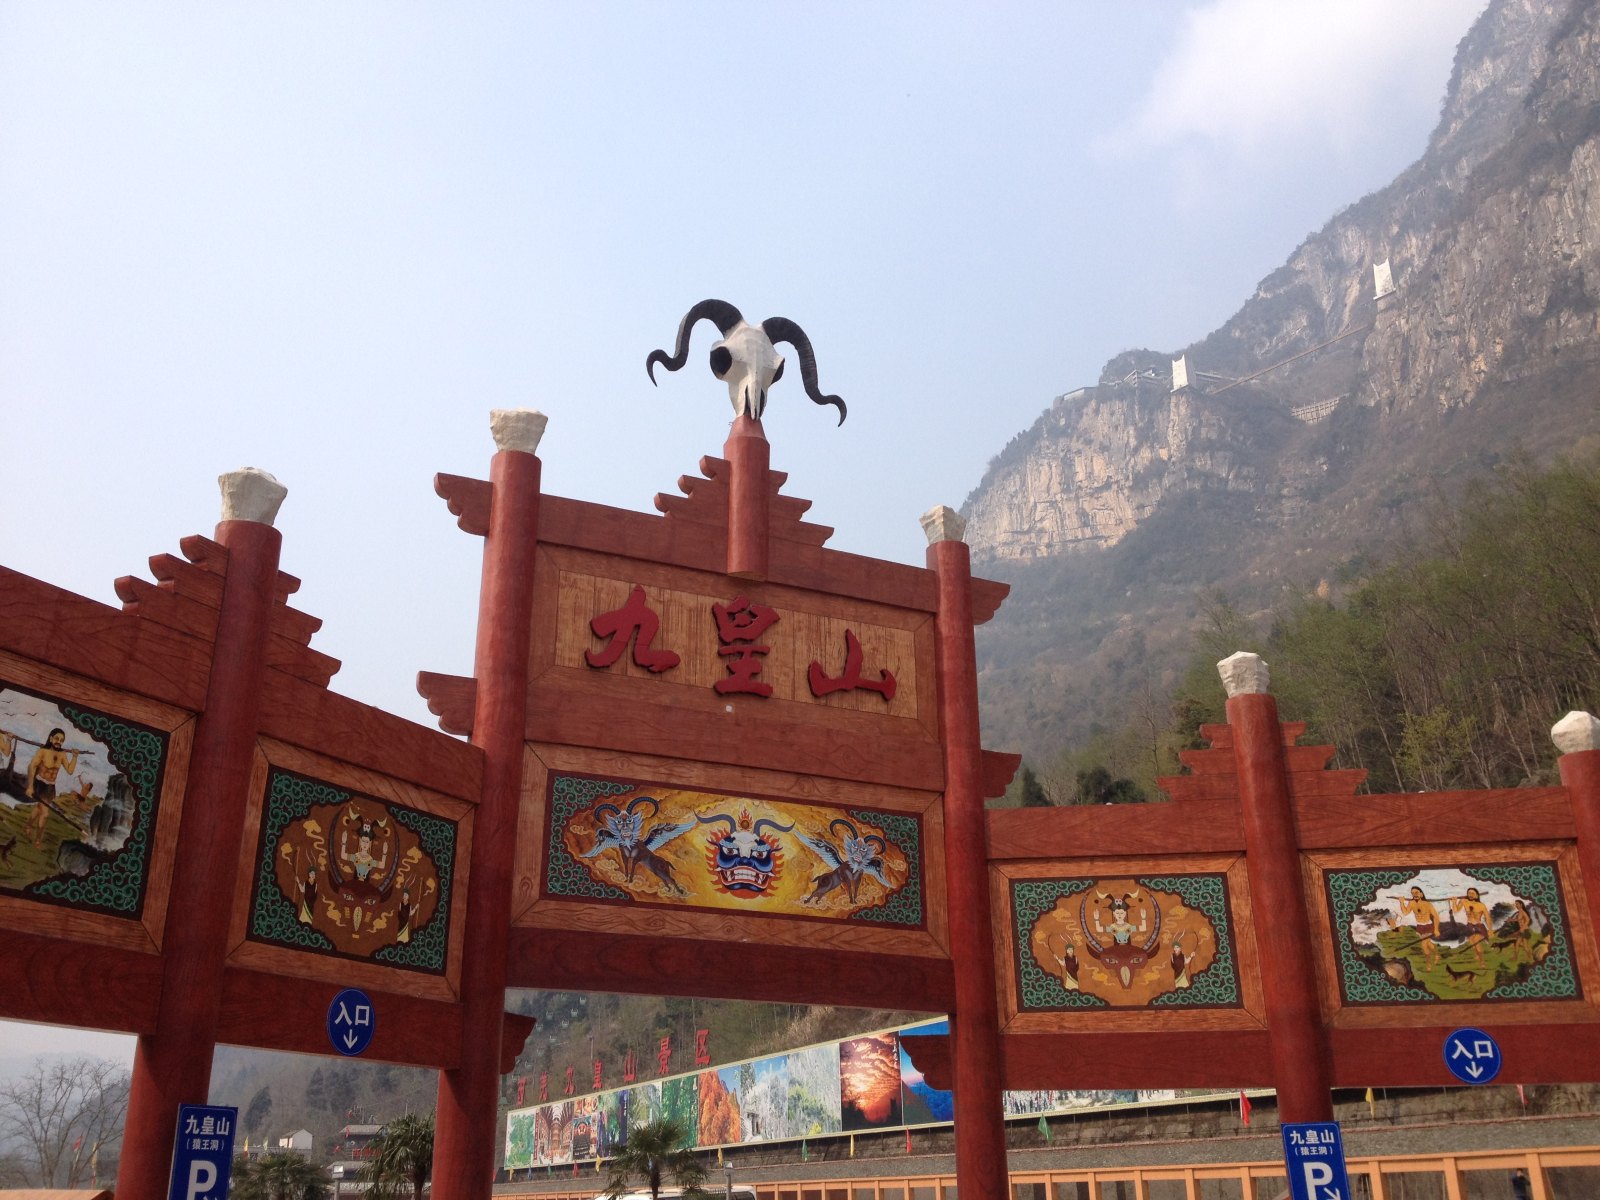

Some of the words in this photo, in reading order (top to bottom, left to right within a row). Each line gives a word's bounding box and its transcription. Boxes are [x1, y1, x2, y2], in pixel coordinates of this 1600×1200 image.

[585, 584, 897, 701] 九皇山
[334, 1001, 370, 1026] 入口
[1452, 1039, 1494, 1060] 入口
[185, 1115, 230, 1136] 九皇山
[1289, 1129, 1335, 1145] 九皇山
[186, 1160, 217, 1200] P
[1303, 1162, 1333, 1200] P
